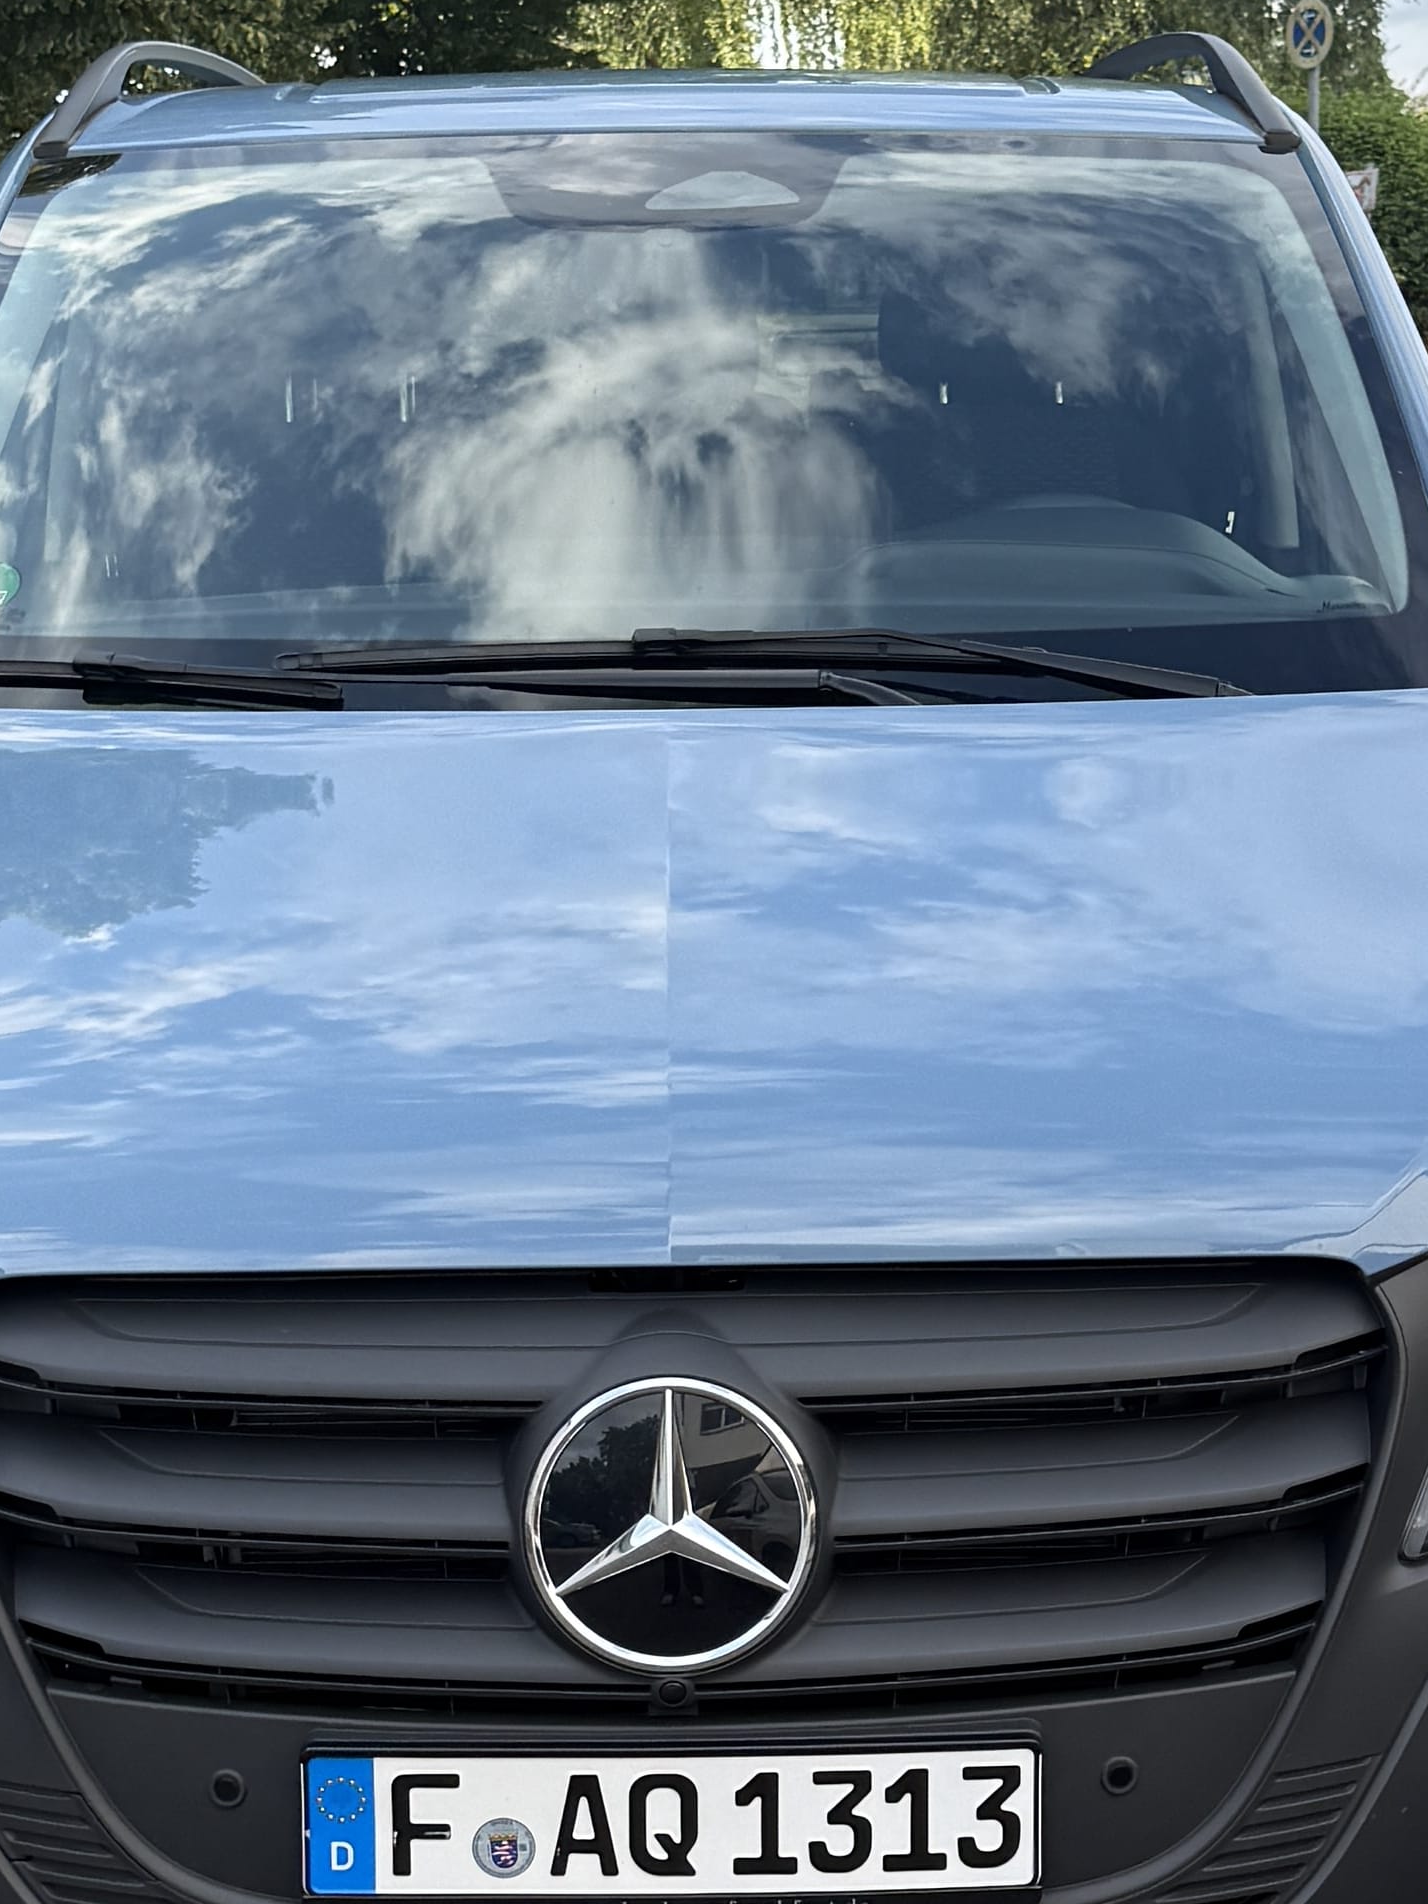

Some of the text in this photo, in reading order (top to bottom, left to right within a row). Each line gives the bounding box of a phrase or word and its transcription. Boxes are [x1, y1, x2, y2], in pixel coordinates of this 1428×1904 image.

[391, 1765, 1021, 1875] F AQ 1313
[330, 1841, 355, 1871] D
